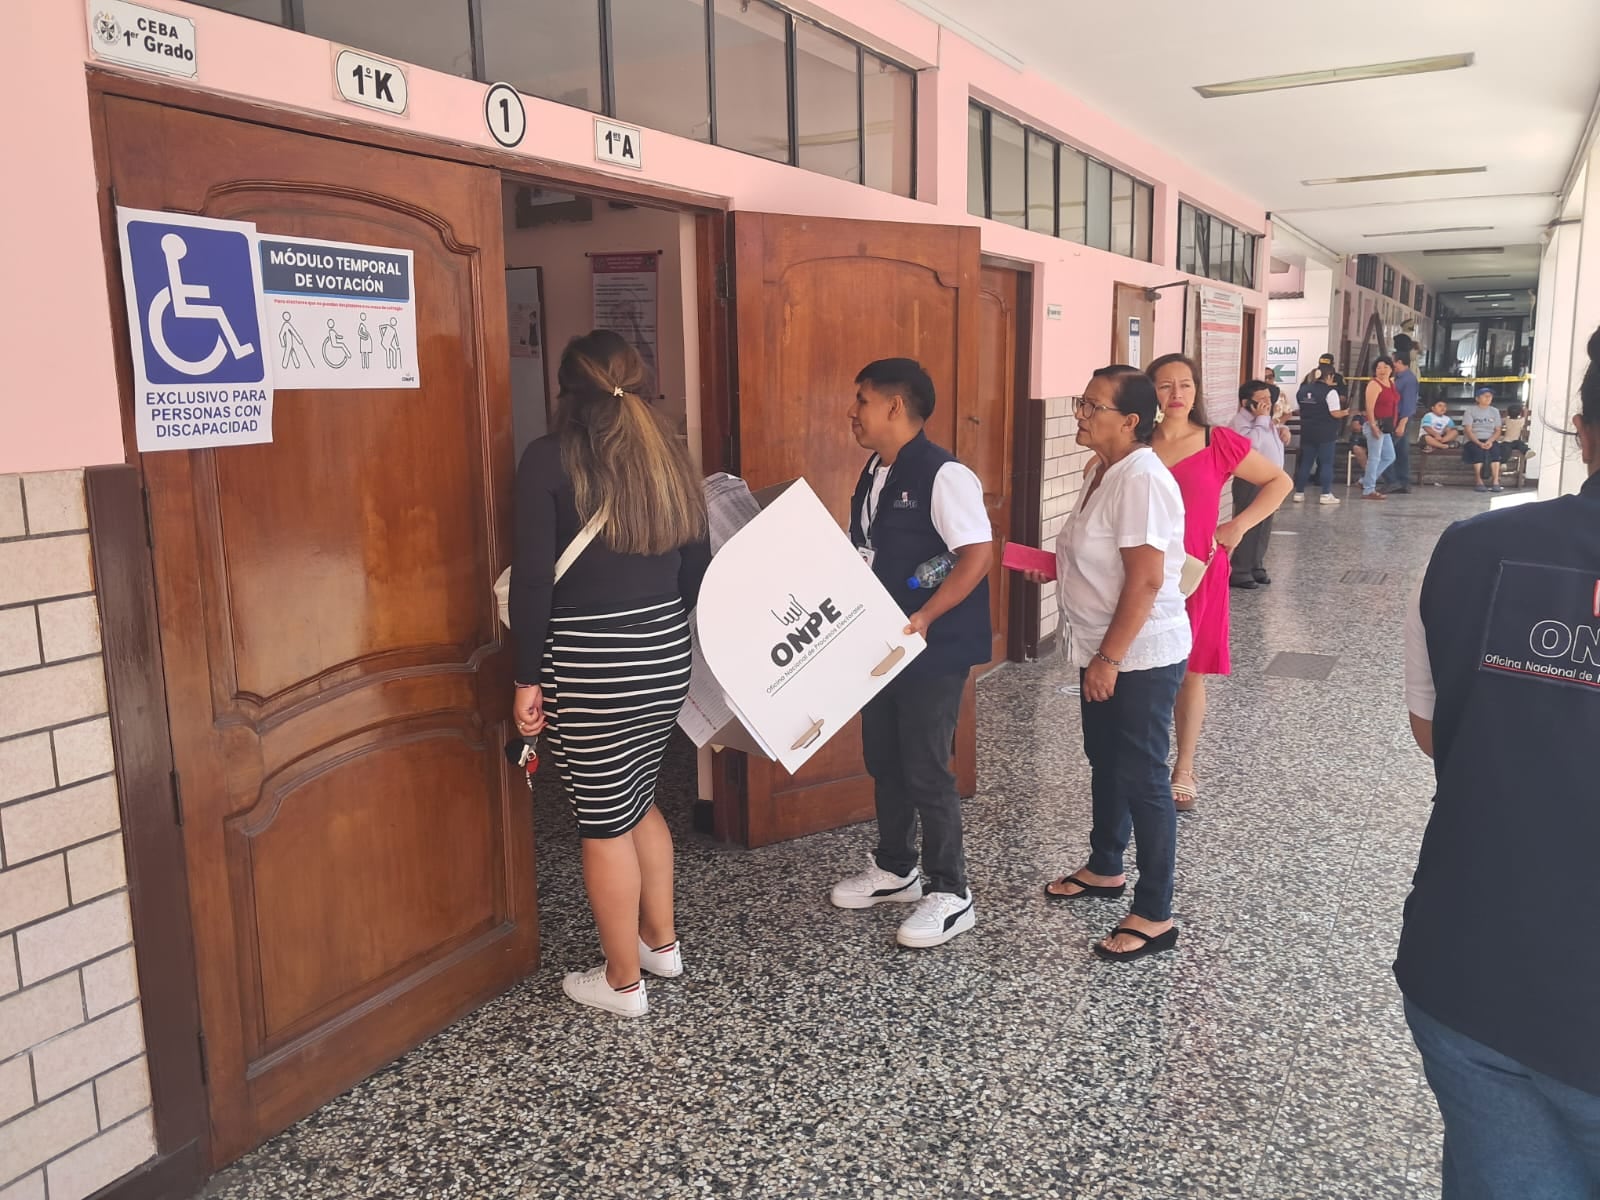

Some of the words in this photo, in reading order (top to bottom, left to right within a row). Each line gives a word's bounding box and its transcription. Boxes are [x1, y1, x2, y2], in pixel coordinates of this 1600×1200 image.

[136, 17, 178, 39] CEBA
[143, 35, 193, 61] Grado
[499, 98, 511, 134] 1
[270, 248, 334, 269] MÓDULO
[336, 257, 402, 276] TEMPORAL
[295, 273, 313, 287] DE
[316, 276, 384, 293] VOTACIÓN
[1268, 346, 1297, 355] SALIDA
[146, 390, 229, 405] EXCLUSIVO
[233, 389, 267, 402] PARA
[151, 406, 231, 421] PERSONAS
[235, 404, 262, 418] CON
[156, 420, 258, 438] DISCAPACIDAD
[771, 597, 842, 667] ONPE
[767, 675, 785, 694] Oficina
[785, 654, 808, 678] Nacional
[1485, 654, 1521, 668] Oficina
[1526, 661, 1576, 677] Nacional
[1579, 670, 1592, 680] de
